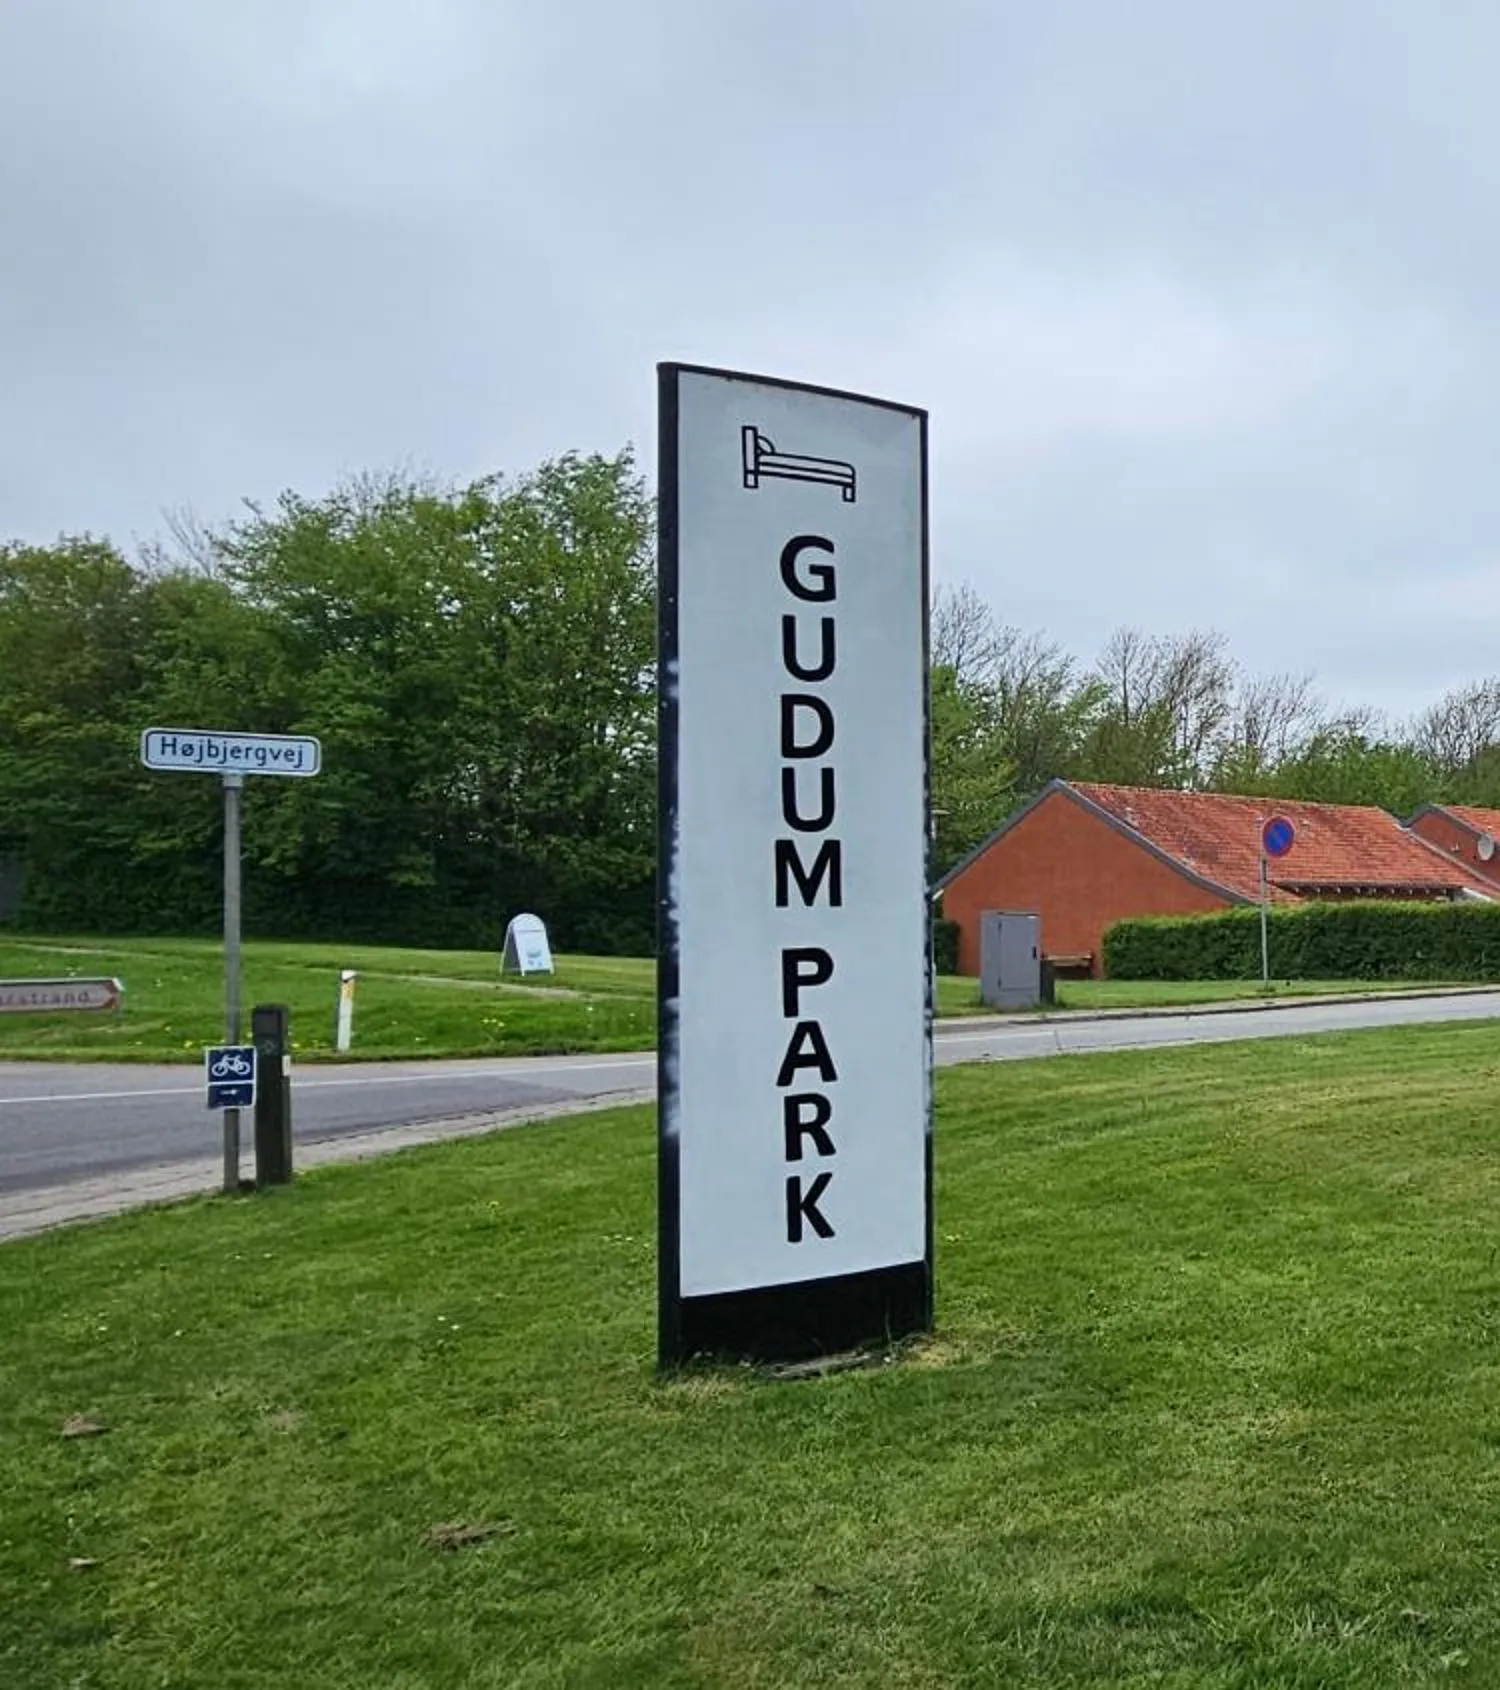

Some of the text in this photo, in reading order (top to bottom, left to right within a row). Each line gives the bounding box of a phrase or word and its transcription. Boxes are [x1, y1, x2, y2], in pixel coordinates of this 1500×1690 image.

[160, 735, 304, 769] Højbjergvej
[775, 534, 842, 1243] GUDUM PARK
